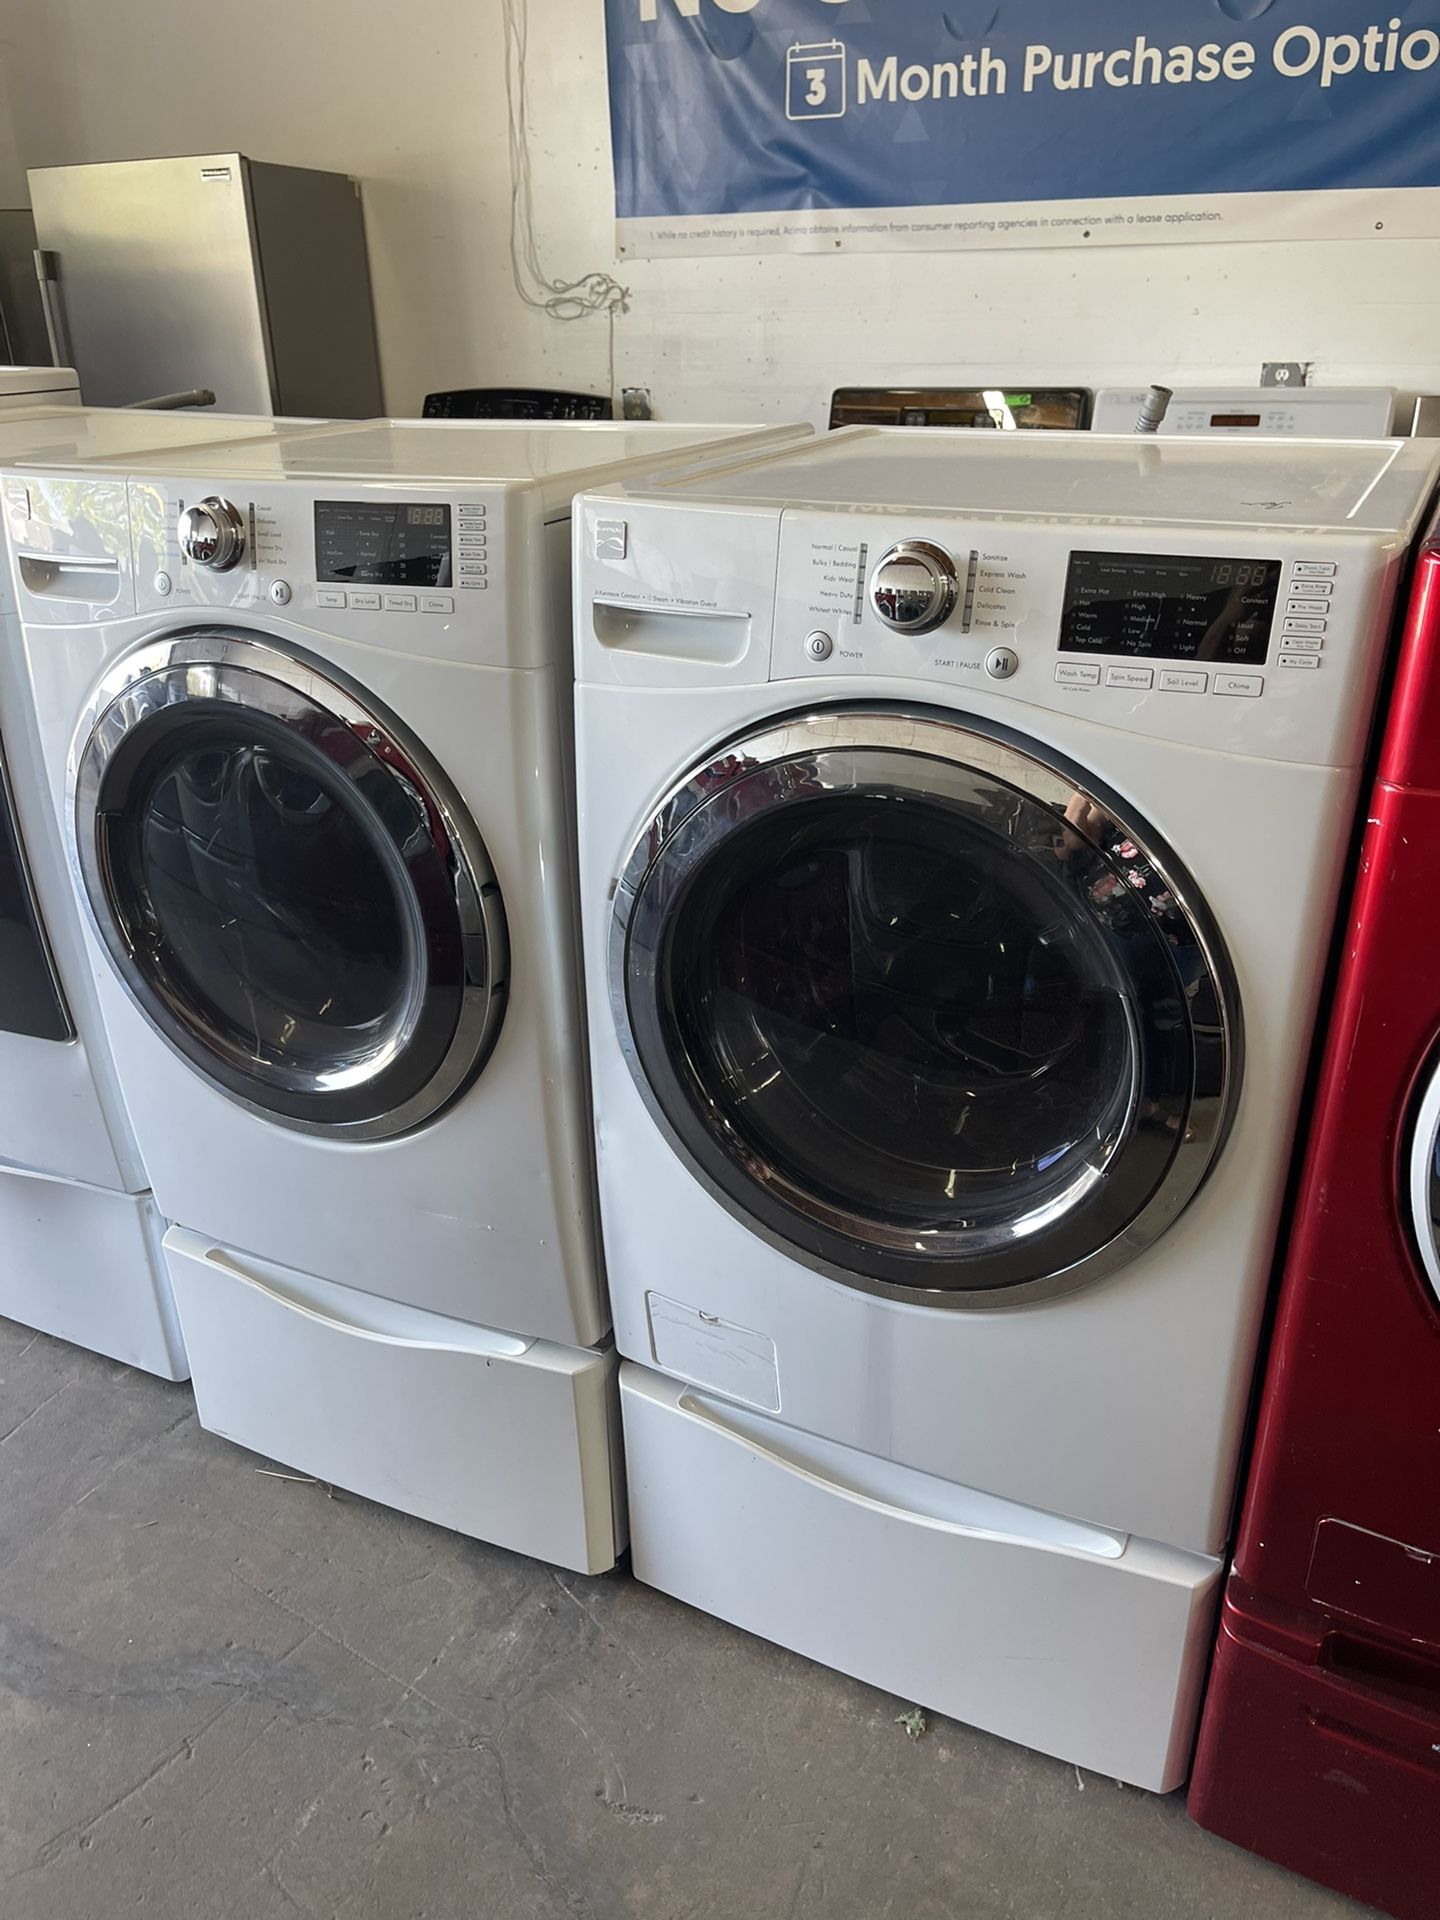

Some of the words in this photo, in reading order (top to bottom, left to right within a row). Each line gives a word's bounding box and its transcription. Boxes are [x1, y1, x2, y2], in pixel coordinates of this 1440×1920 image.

[805, 69, 827, 106] 3
[857, 47, 1007, 104] Month
[1023, 36, 1256, 93] Purchase
[1272, 18, 1440, 88] Optio
[656, 231, 676, 240] While
[689, 230, 711, 239] credit
[712, 229, 737, 239] history
[809, 225, 839, 235] obtains
[841, 223, 888, 233] information
[889, 222, 909, 232] from
[911, 223, 952, 232] consumer
[954, 220, 995, 232] reporting
[997, 217, 1038, 230] agencies
[1040, 217, 1049, 227] in
[1051, 215, 1102, 226] connection
[1104, 214, 1125, 224] with
[1127, 216, 1134, 224] a
[1136, 213, 1162, 224] lease
[1164, 211, 1224, 224] application.
[811, 543, 834, 552] Normal
[837, 544, 858, 553] Casual
[982, 553, 1009, 562] Sanitize
[812, 558, 828, 567] Bulky
[832, 560, 857, 570] Bedding
[980, 569, 1005, 579] Express
[1007, 571, 1027, 580] Wash
[820, 590, 838, 599] Heavy
[839, 591, 854, 600] Duty
[978, 585, 995, 594] Cold
[995, 586, 1016, 595] Clean
[1080, 586, 1097, 595] Extra
[1132, 590, 1150, 599] Extra
[1150, 591, 1167, 600] High
[621, 591, 641, 600] Connect
[676, 596, 699, 606] Vibration
[700, 599, 718, 608] Guard
[1185, 592, 1208, 602] Heavy
[1240, 596, 1269, 605] Connect
[976, 601, 1007, 611] Delicates
[1130, 603, 1147, 611] High
[832, 608, 853, 616] Whites
[974, 619, 992, 627] Rinse
[1001, 620, 1016, 629] Spin
[1076, 623, 1092, 631] Cold
[1182, 618, 1208, 627] Normal
[1127, 627, 1141, 635] Low
[1087, 636, 1103, 645] Cold
[1126, 639, 1137, 647] No
[1178, 643, 1196, 653] Light
[1233, 646, 1247, 655] Off
[839, 650, 864, 659] POWER
[934, 659, 955, 668] START
[959, 661, 981, 671] PAUSE
[1058, 669, 1079, 679] Wash
[1079, 671, 1098, 681] Temp
[1110, 673, 1126, 683] Spin
[1126, 674, 1149, 684] Speed
[1166, 677, 1180, 686] Soil
[1180, 678, 1200, 688] Level
[1227, 681, 1251, 690] Chime
